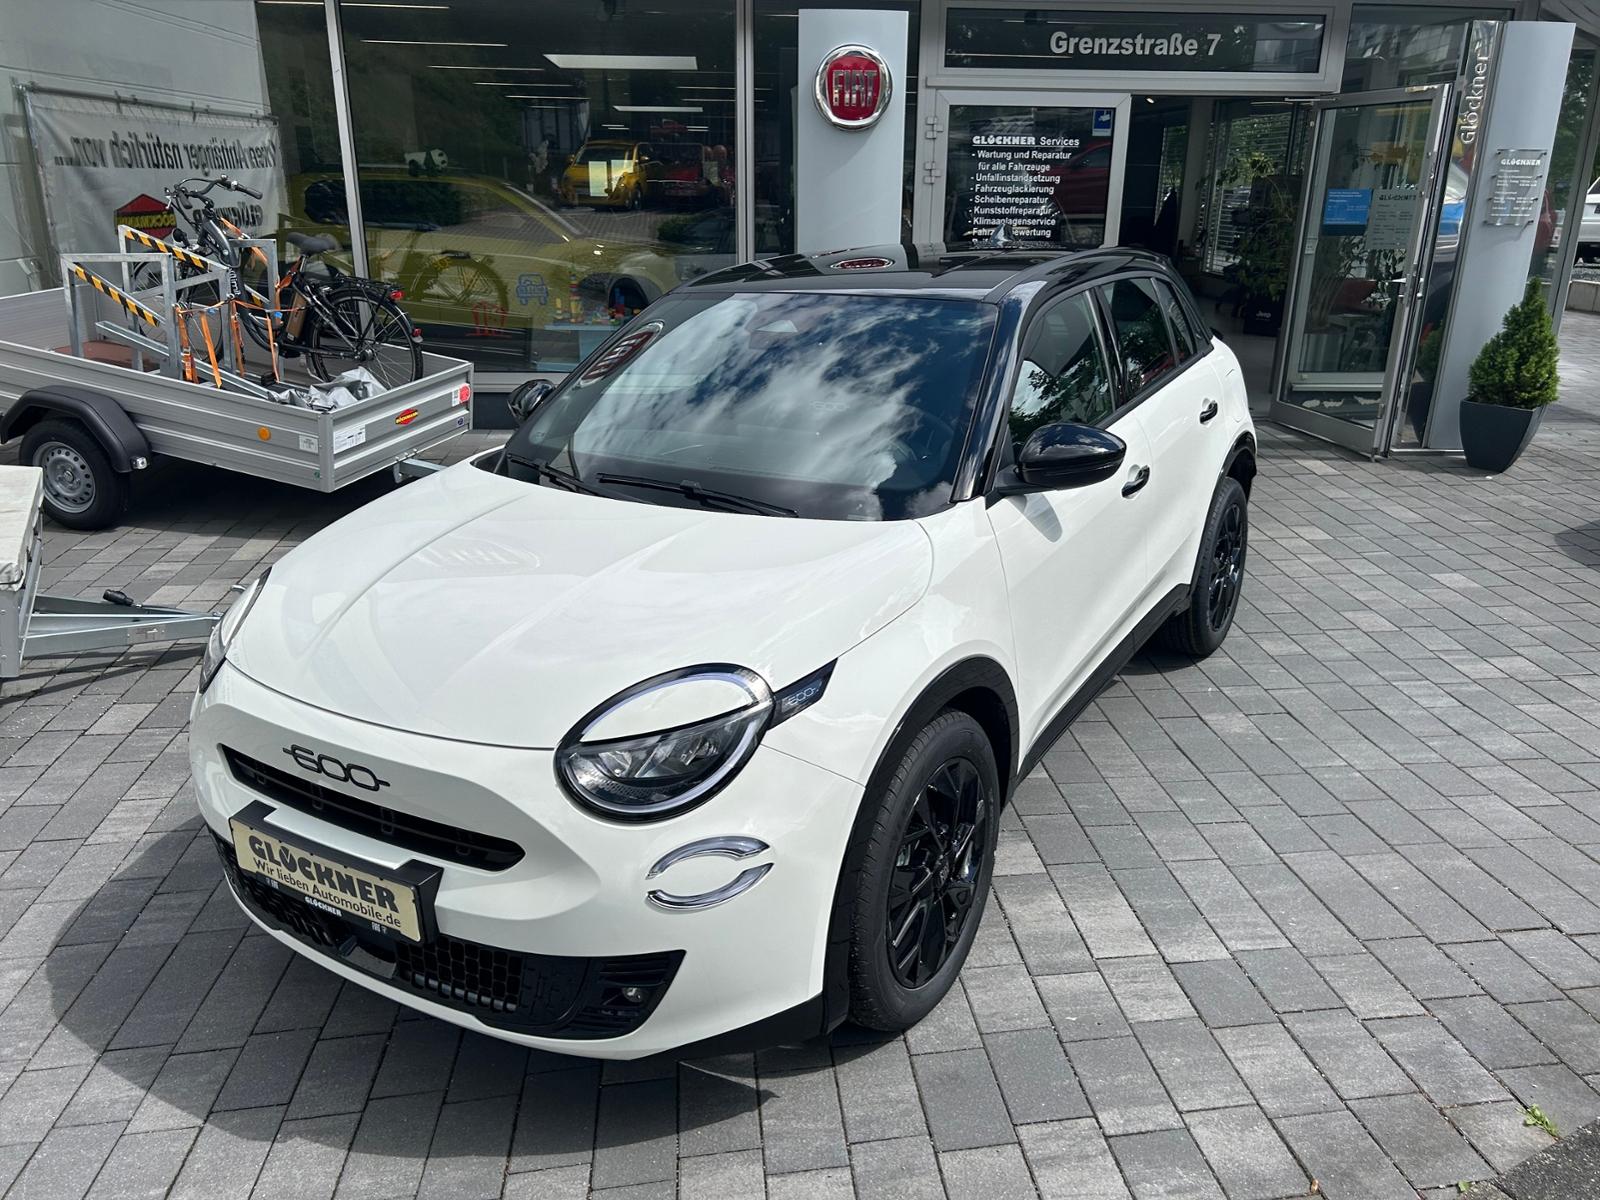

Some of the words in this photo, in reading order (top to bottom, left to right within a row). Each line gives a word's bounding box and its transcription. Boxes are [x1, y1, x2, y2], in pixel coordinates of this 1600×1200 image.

[1050, 31, 1198, 56] Grenzstraße
[1206, 33, 1222, 56] 7
[832, 70, 877, 106] FIAT
[1460, 53, 1489, 144] Glöckner
[972, 135, 1036, 145] GLÖCKNER
[1039, 136, 1080, 146] Services
[977, 150, 1012, 160] Wartung
[1013, 150, 1030, 159] und
[1031, 150, 1072, 160] Reparatur
[978, 162, 990, 171] für
[991, 162, 1006, 171] alle
[1008, 162, 1051, 173] Fahrzeuge
[976, 173, 1061, 184] Unfallinstandsetzung
[975, 184, 1055, 195] Fahrzeuglackierung
[974, 195, 1049, 205] Scheibenreparatur
[973, 206, 1053, 216] Kunststoffreparatur
[973, 217, 1056, 227] Klimaanlagenservice
[285, 744, 387, 792] 600
[253, 858, 275, 876] Wir
[276, 867, 310, 892] lieben
[312, 884, 401, 927] Automobile.de
